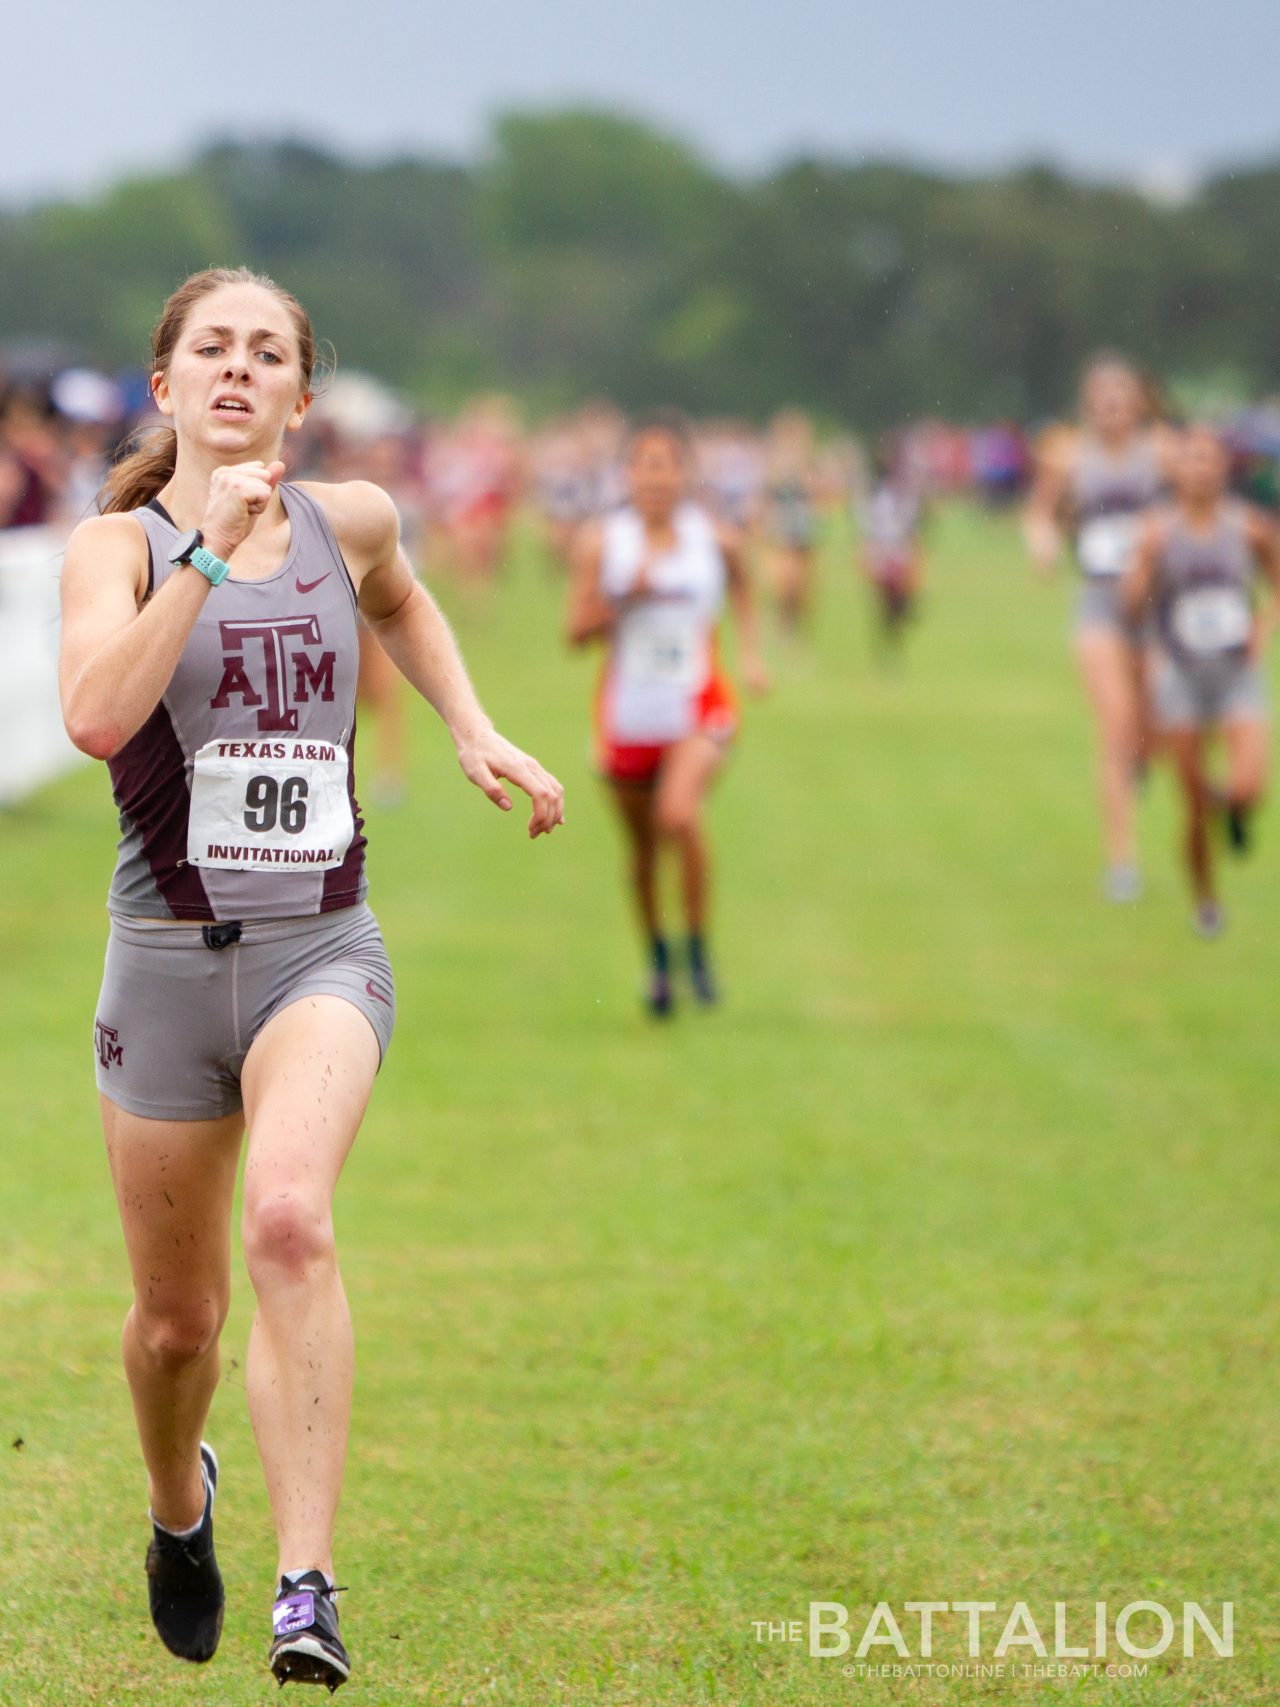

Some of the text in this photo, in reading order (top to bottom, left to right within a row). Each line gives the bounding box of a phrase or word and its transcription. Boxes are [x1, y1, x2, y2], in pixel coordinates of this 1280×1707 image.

[217, 743, 336, 762] TEXAS A&M
[243, 775, 309, 835] 96
[207, 844, 334, 863] INVITATIONAL
[277, 1620, 307, 1633] LYNX
